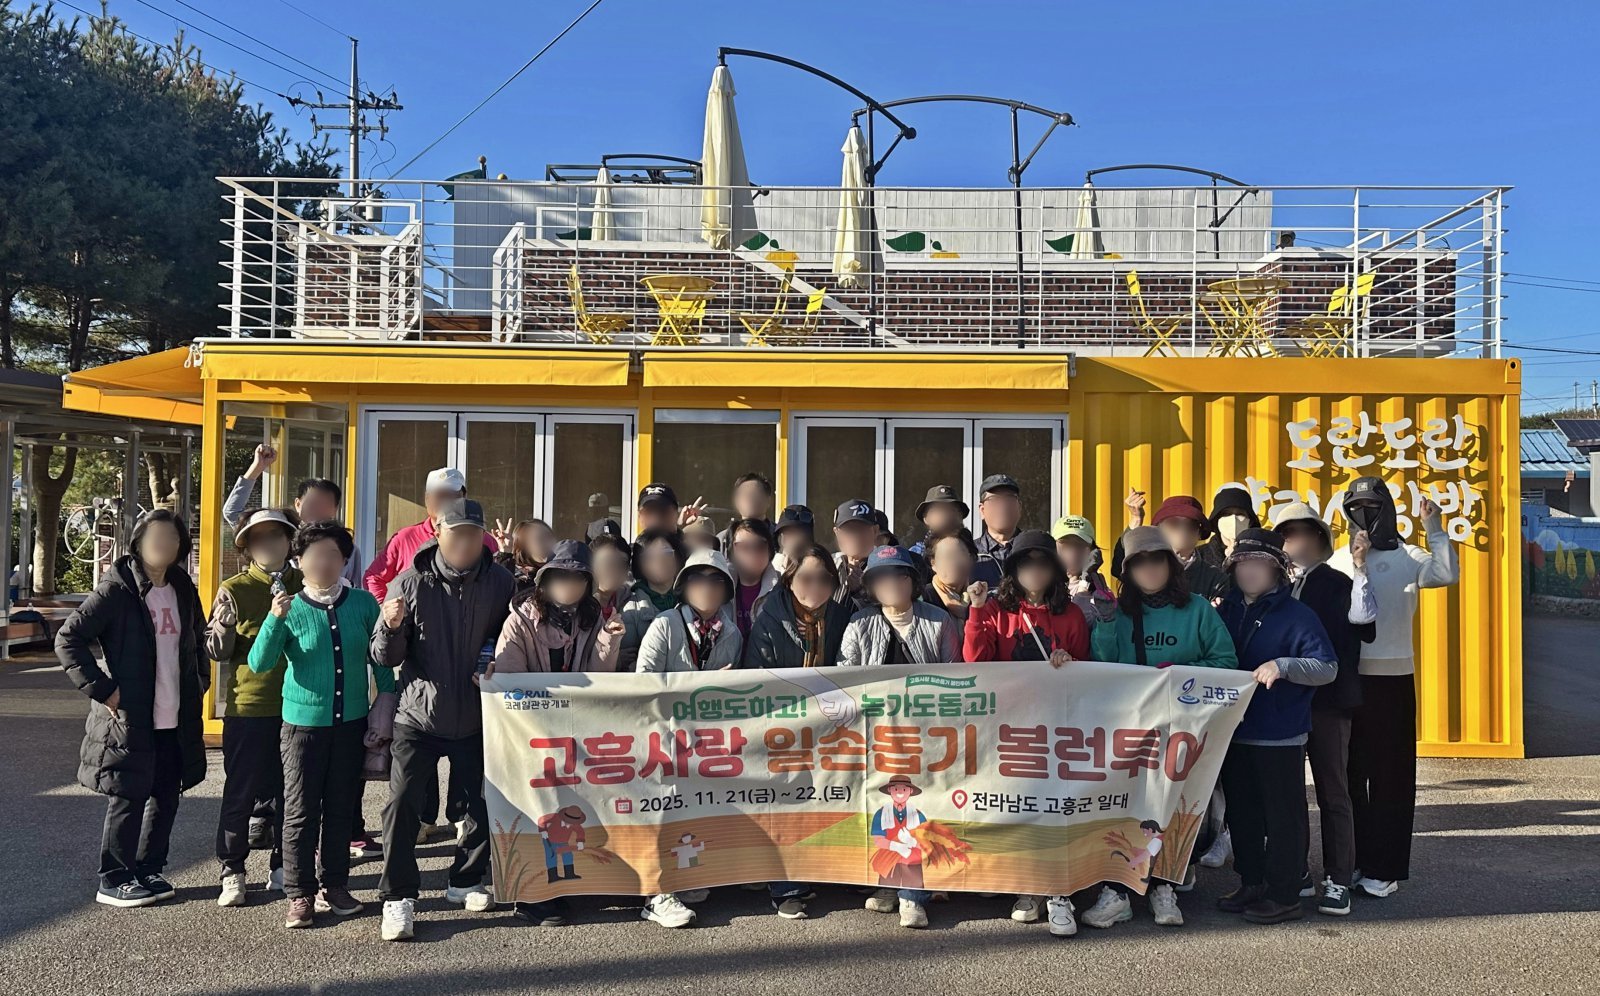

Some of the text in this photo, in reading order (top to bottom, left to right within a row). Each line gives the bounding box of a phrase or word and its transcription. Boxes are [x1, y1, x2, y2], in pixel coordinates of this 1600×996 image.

[1286, 410, 1474, 471] 도란도란
[1131, 632, 1178, 646] ello
[504, 688, 552, 700] KORAIL
[505, 699, 570, 710] 코레일관광개발
[673, 684, 996, 721] 여행도하고! 농가도돕고!
[1203, 686, 1239, 700] 고흥군
[529, 723, 1208, 788] 고흥사랑 일손돕기 볼런투어
[639, 794, 689, 813] 2025.
[695, 791, 720, 805] 11.
[726, 788, 776, 804] 21(금)
[796, 785, 851, 803] 22.(토)
[972, 792, 1129, 815] 전라남도 고흥군 일대
